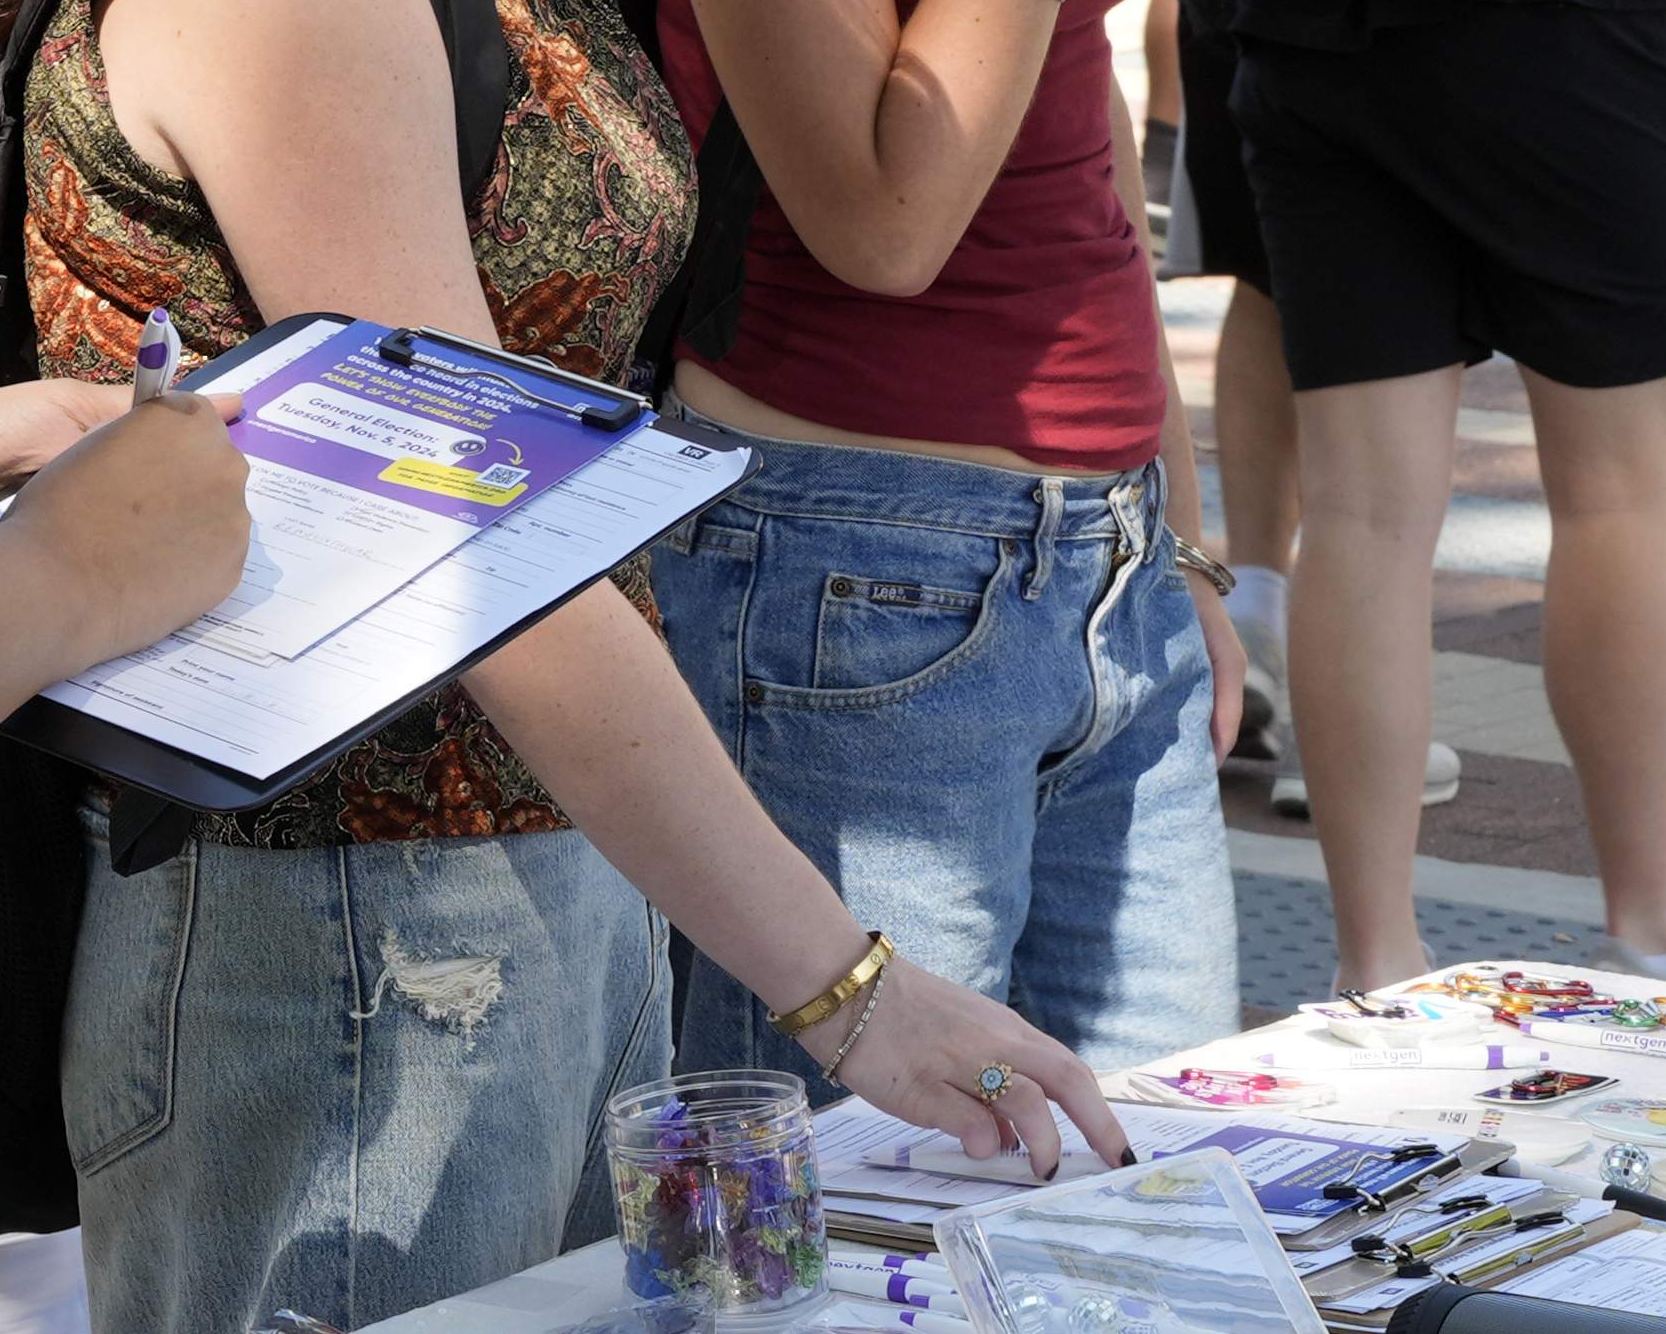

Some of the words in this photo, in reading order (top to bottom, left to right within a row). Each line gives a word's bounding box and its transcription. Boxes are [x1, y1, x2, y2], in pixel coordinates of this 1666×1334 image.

[347, 354, 390, 373] across
[389, 368, 412, 381] the
[412, 377, 464, 398] country
[462, 390, 477, 402] in
[476, 396, 512, 413] 2024.
[480, 386, 540, 409] elections
[308, 397, 374, 423] General
[371, 417, 440, 444] Election:
[471, 408, 498, 421] THE
[277, 402, 341, 430] Tuesday,
[345, 424, 376, 441] Nov.
[380, 435, 395, 448] 5,
[397, 441, 440, 458] 2024
[684, 446, 704, 458] VR
[1353, 1048, 1419, 1064] nextgen
